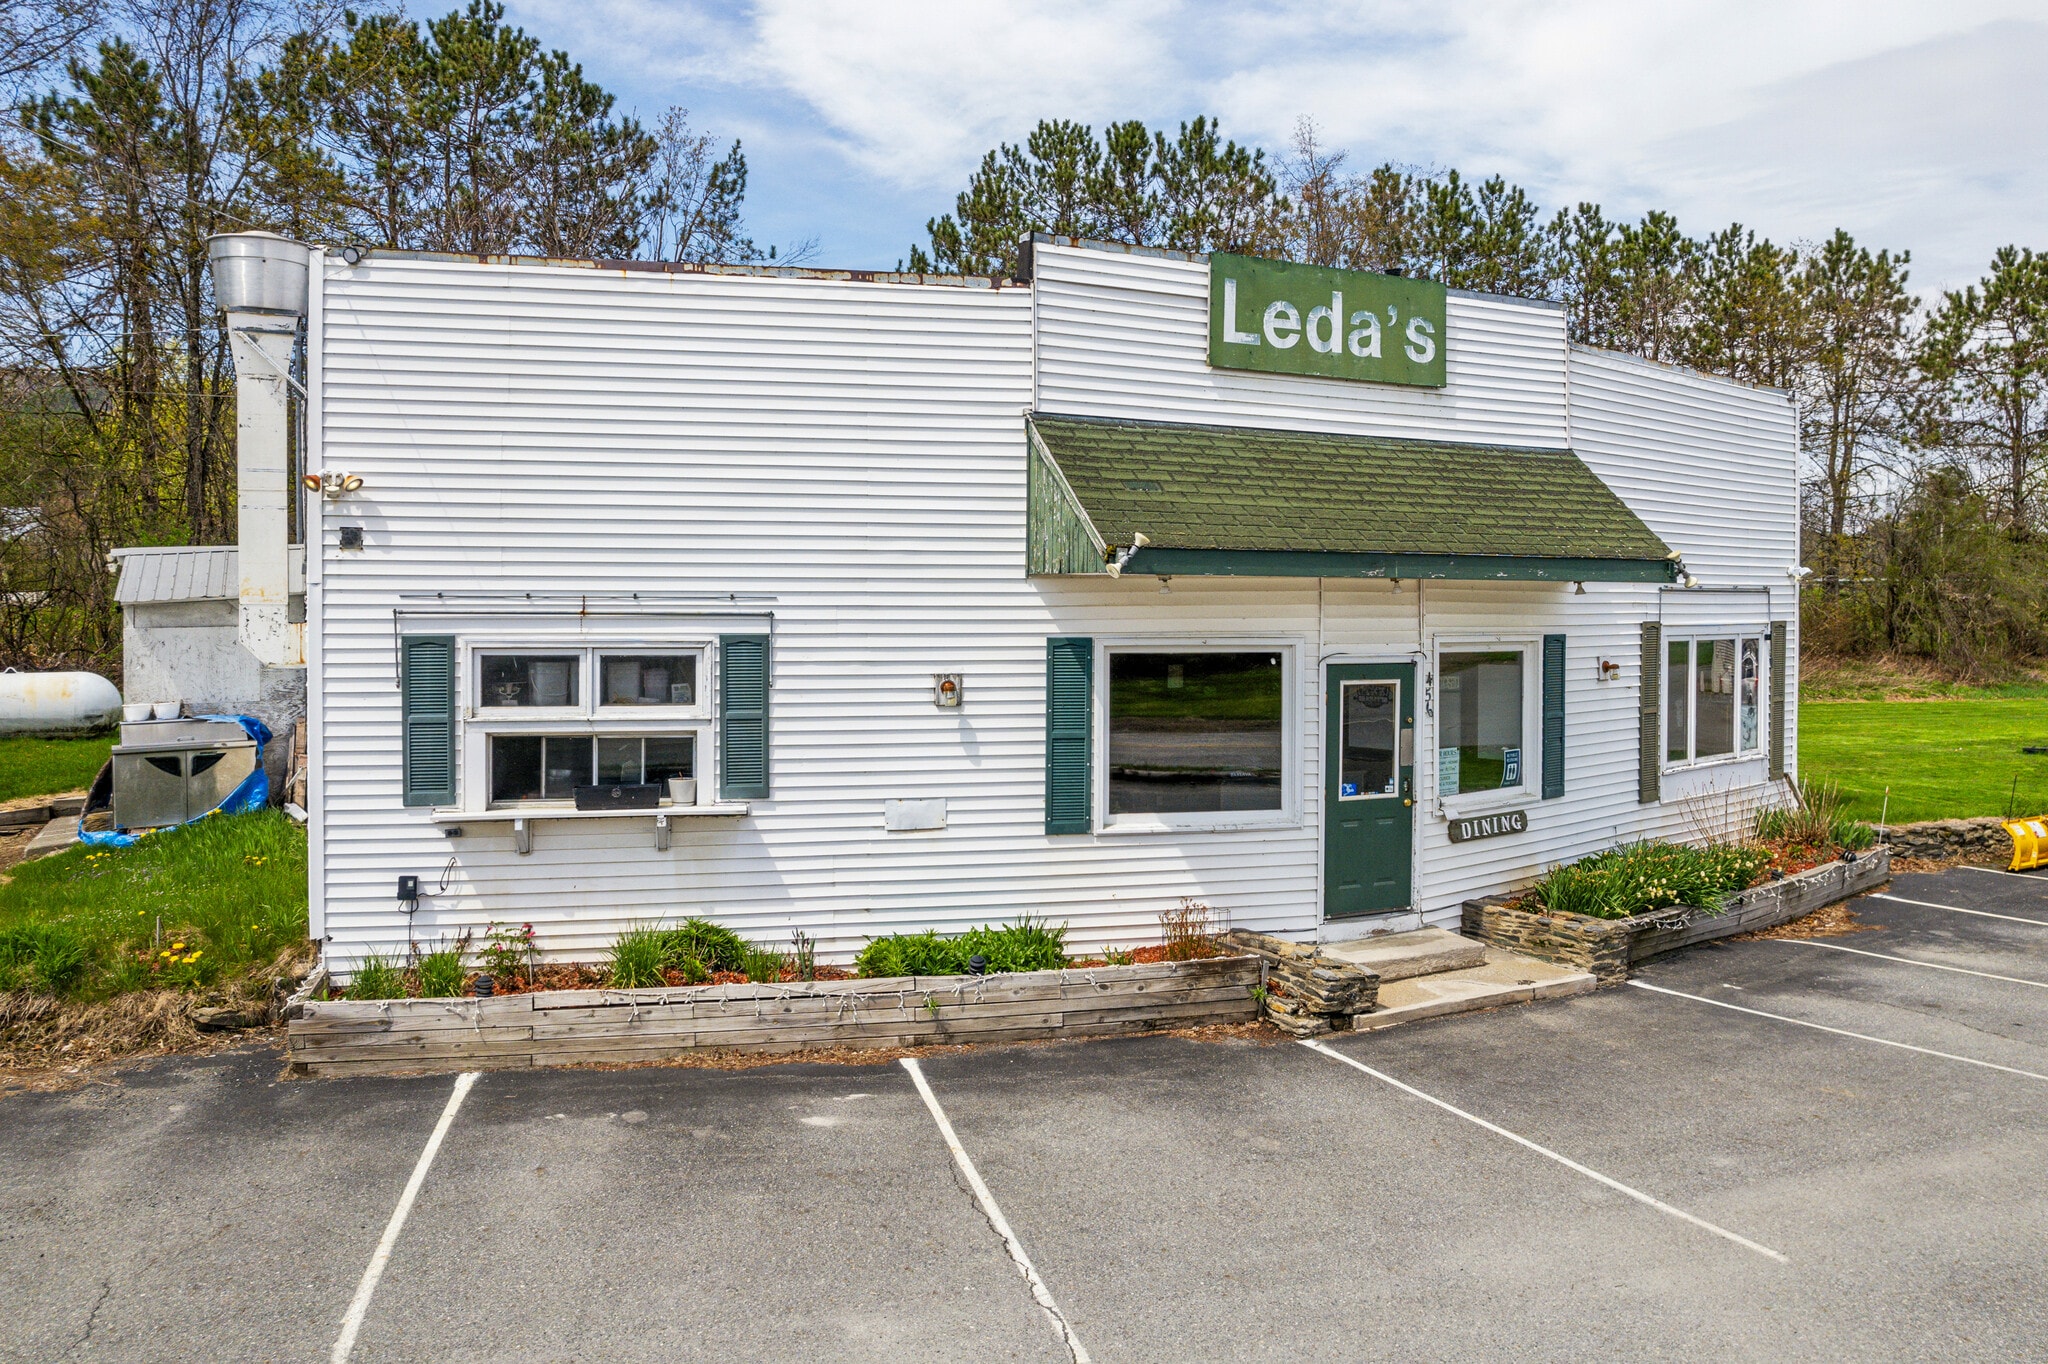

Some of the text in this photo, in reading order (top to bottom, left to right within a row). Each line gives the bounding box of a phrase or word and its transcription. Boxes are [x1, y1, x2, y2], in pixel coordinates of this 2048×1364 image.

[1223, 278, 1436, 364] Leda's
[1425, 671, 1434, 718] 456
[1461, 814, 1522, 840] DINING
